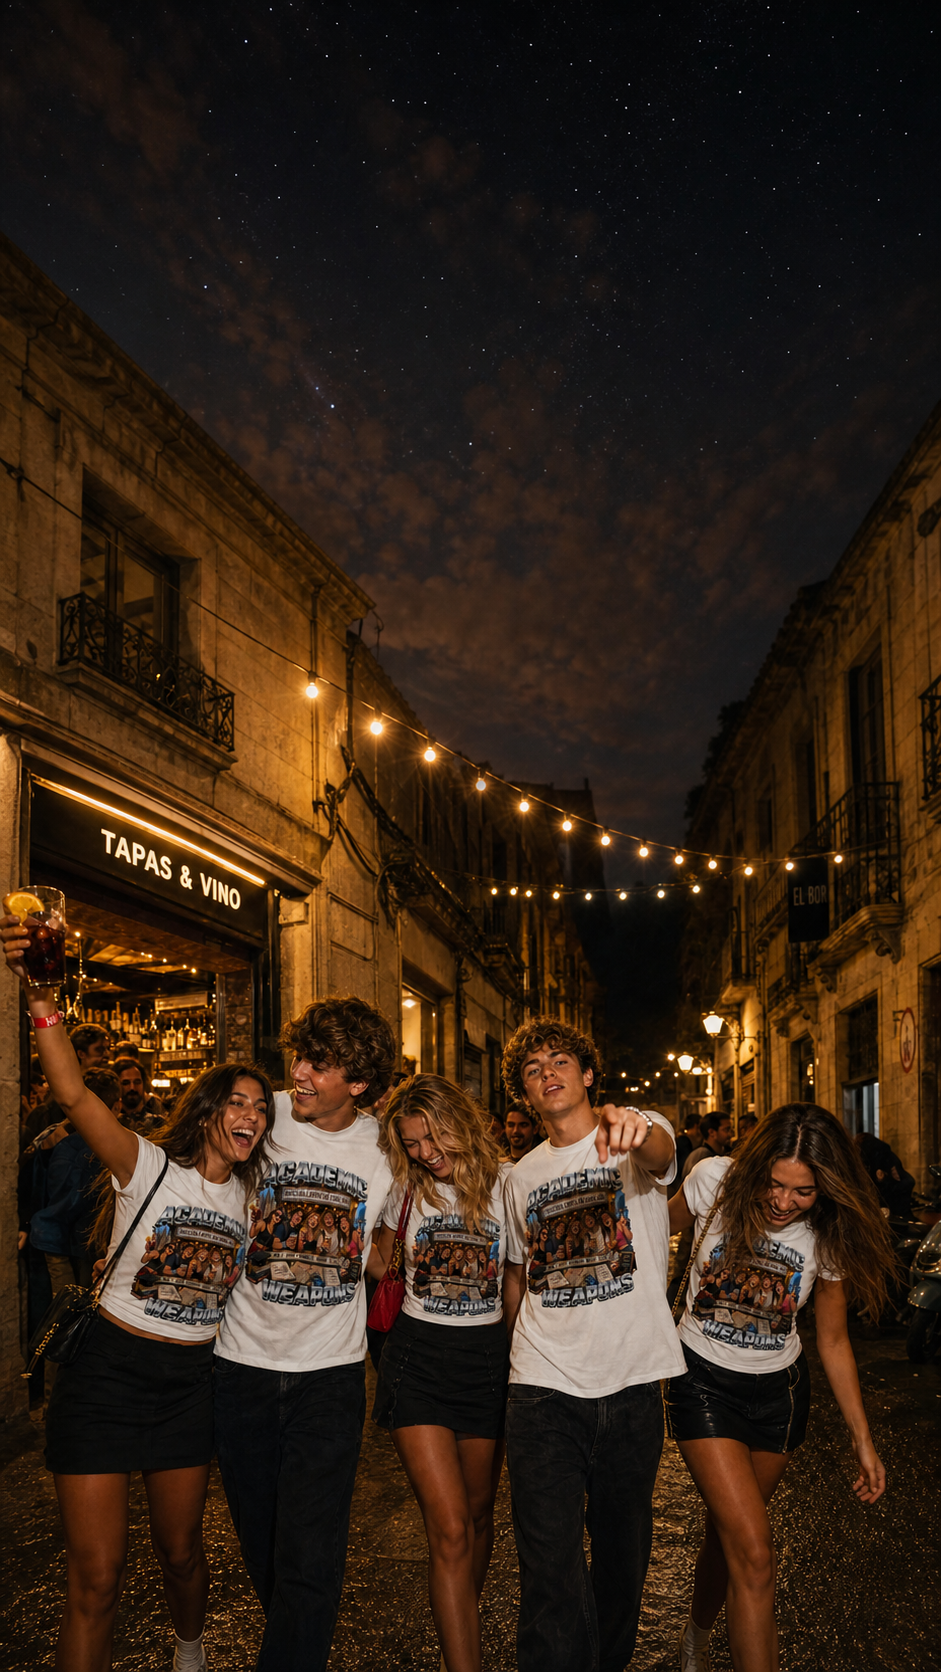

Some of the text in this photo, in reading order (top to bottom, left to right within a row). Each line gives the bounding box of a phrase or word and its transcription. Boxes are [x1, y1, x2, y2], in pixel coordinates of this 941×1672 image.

[101, 828, 241, 910] TAPAS & VINO
[793, 884, 827, 906] EL BOR
[261, 1161, 368, 1199] ACADEMIC
[527, 1167, 623, 1215] ACADEMIC
[262, 1278, 356, 1307] WEAPONS
[541, 1273, 634, 1309] WEAPONS
[702, 1319, 786, 1351] WEAPONS
